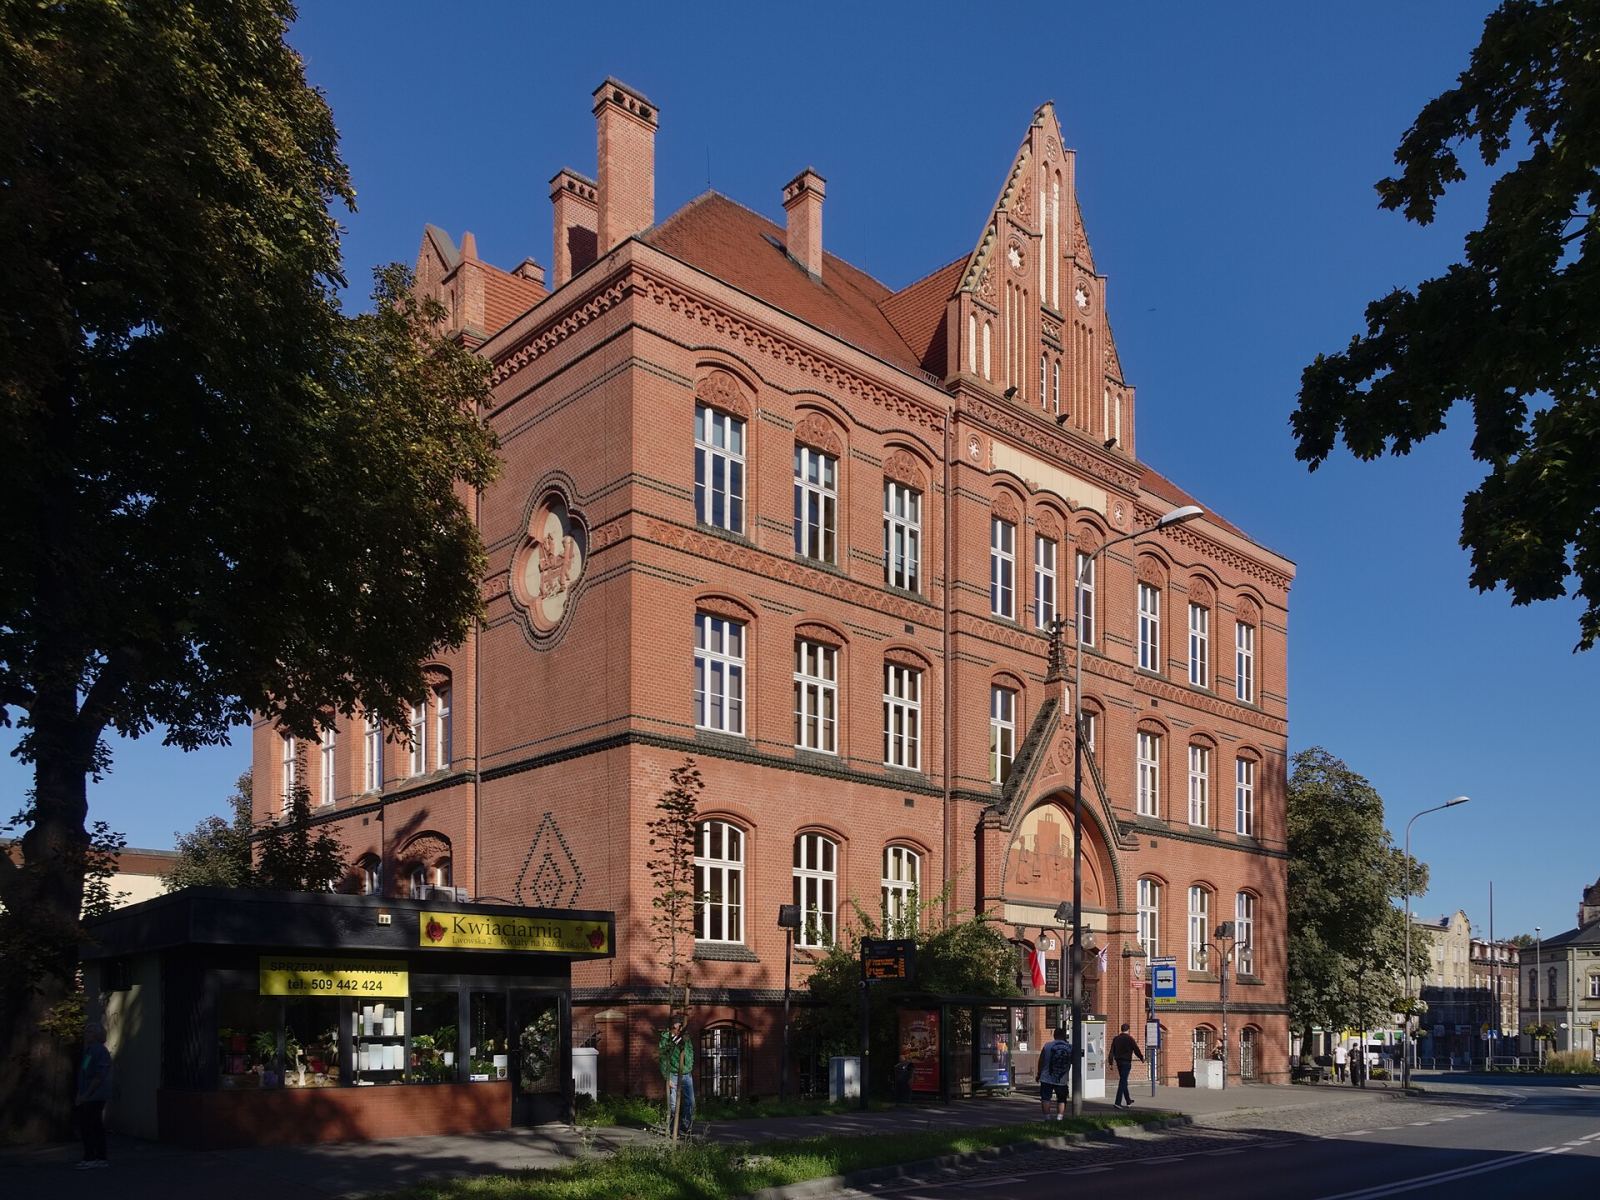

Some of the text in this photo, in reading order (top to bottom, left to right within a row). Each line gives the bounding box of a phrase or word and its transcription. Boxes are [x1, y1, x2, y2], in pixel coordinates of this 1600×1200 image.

[452, 916, 562, 939] Kwiaciarnia
[452, 935, 486, 945] Lwowska
[487, 937, 493, 945] 2
[501, 937, 528, 947] Kwiaty
[288, 979, 383, 991] tel. 509 442 424
